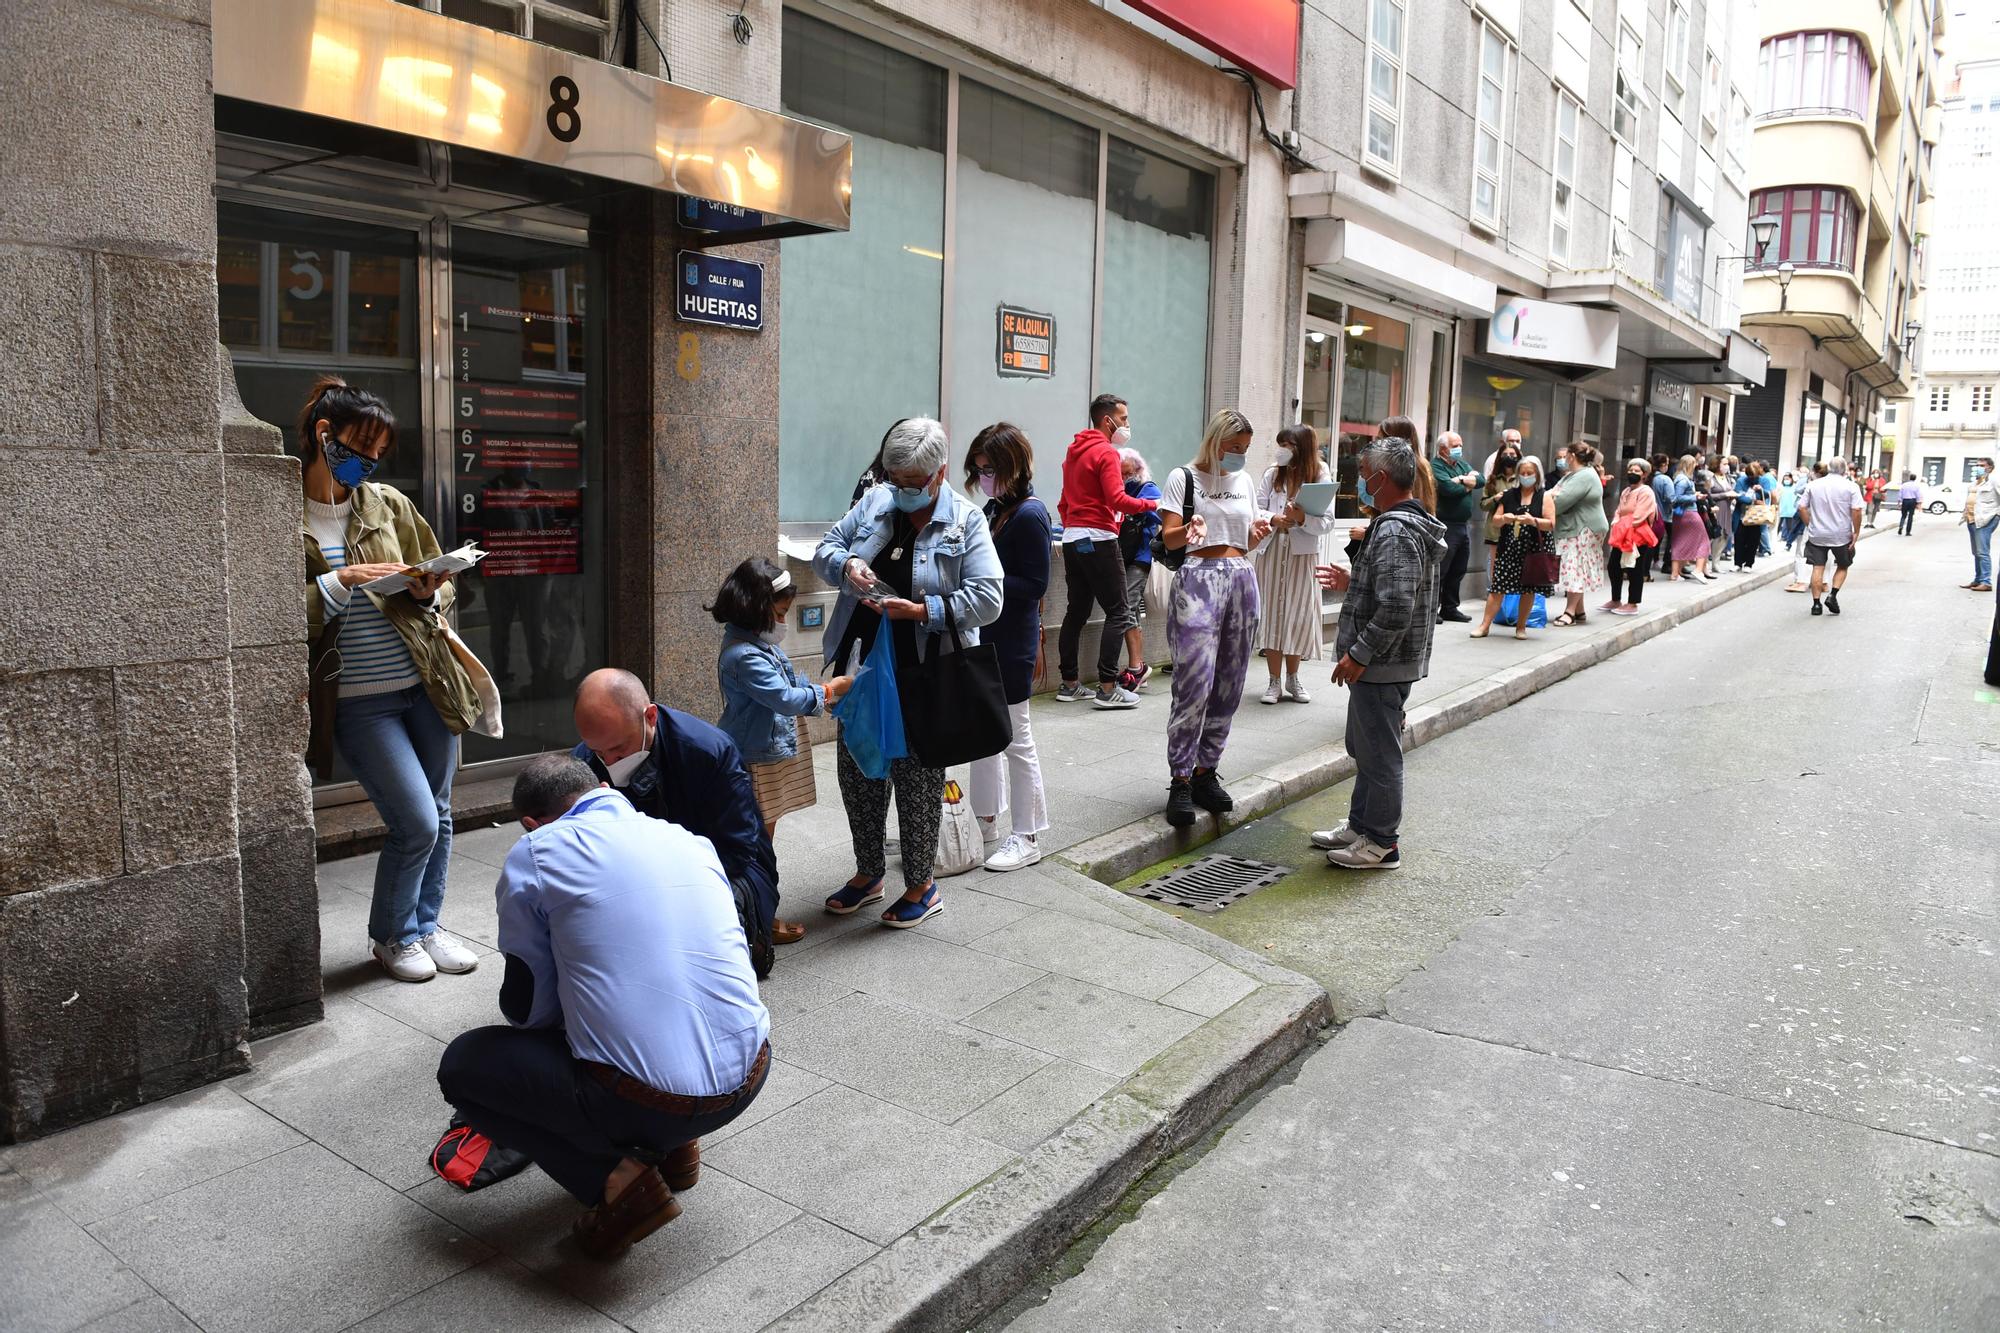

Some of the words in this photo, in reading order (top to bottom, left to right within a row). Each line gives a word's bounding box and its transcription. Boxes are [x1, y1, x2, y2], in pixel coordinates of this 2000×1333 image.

[547, 75, 581, 143] 8
[708, 273, 727, 286] CALLE
[732, 277, 745, 288] RUA
[684, 294, 758, 321] HUERTAS
[459, 312, 468, 332] 1
[1004, 314, 1015, 332] SE
[1015, 317, 1049, 337] ALQUILA
[462, 347, 469, 358] 2
[676, 331, 701, 382] 8
[462, 360, 469, 370] 3
[462, 373, 469, 382] 4
[460, 397, 474, 417] 5
[462, 429, 472, 445] 6
[462, 453, 476, 472] 7
[462, 493, 476, 514] 8
